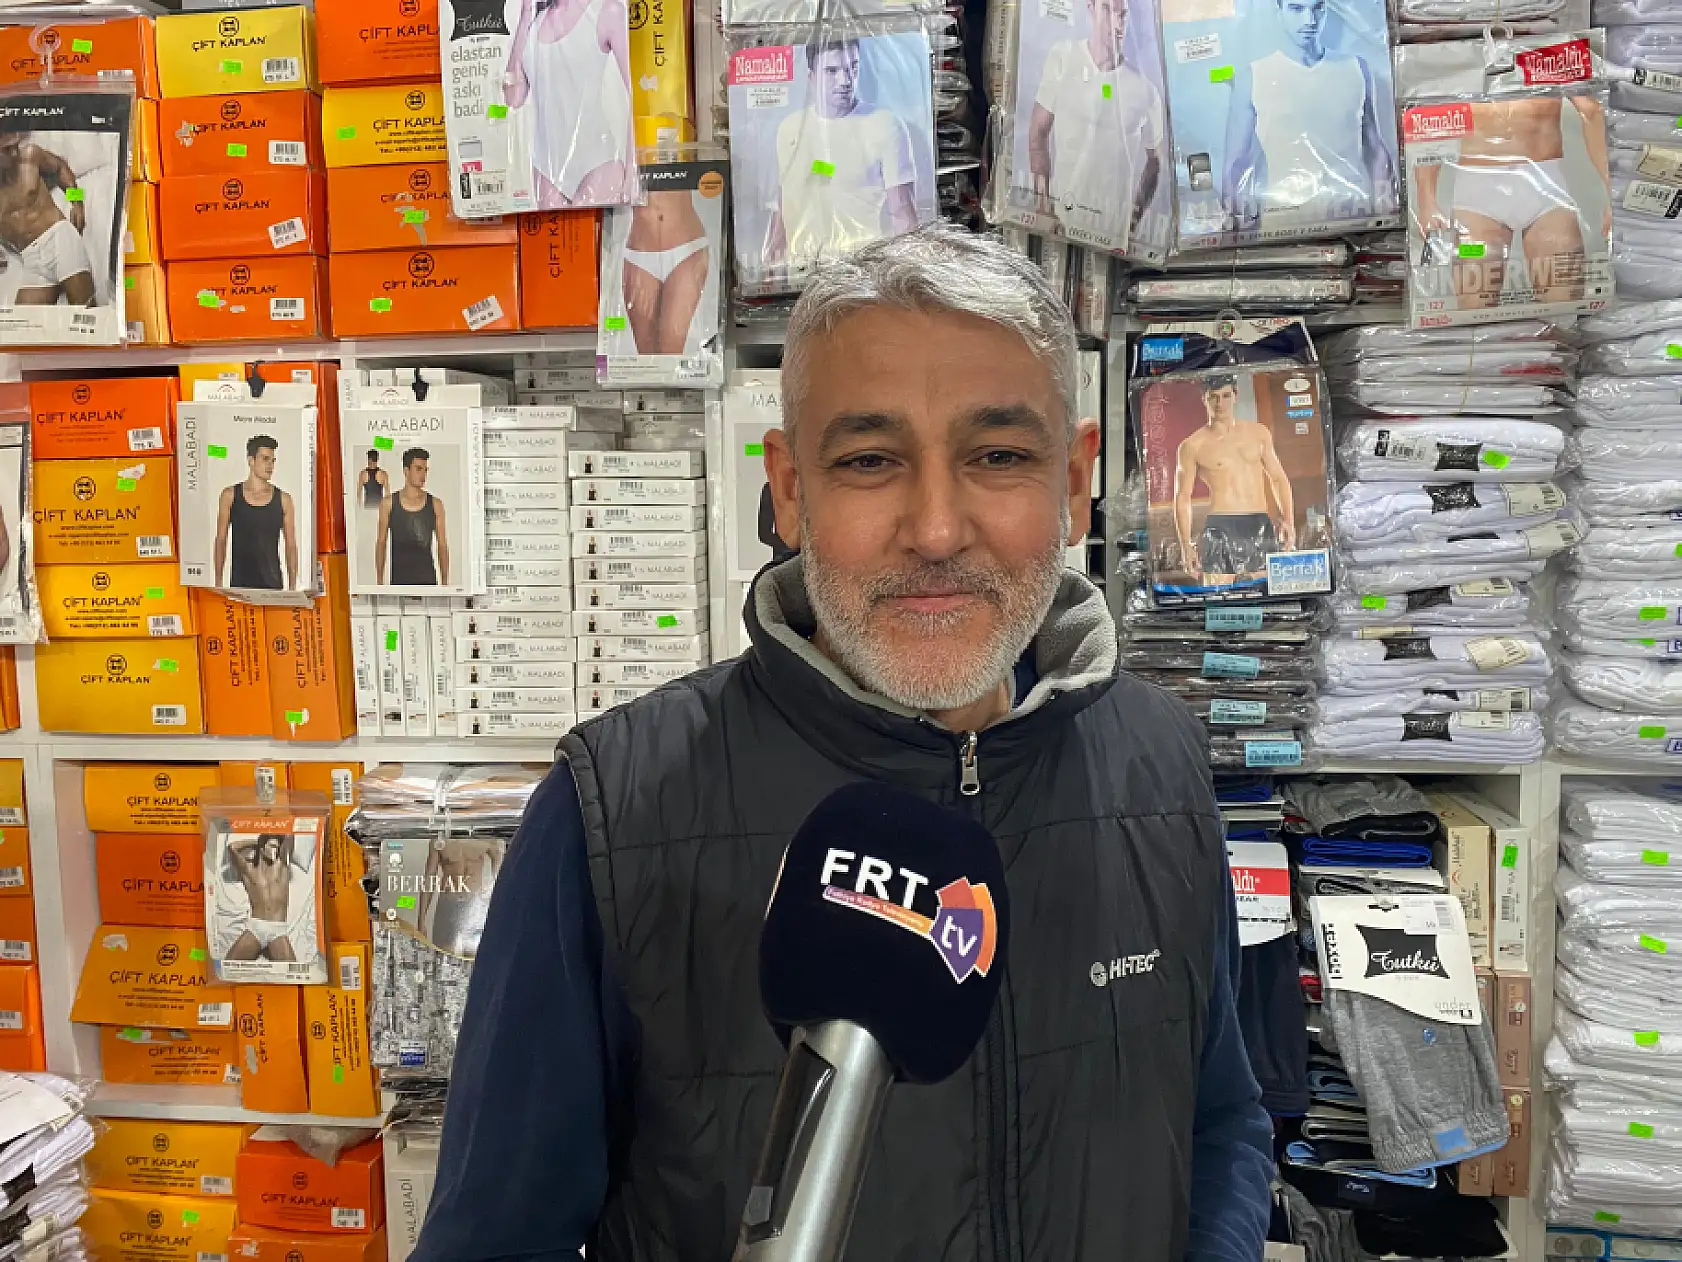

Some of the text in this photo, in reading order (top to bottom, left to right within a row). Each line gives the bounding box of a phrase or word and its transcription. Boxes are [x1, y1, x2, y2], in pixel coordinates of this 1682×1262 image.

[451, 45, 502, 62] elastan
[452, 61, 489, 83] geniş
[69, 409, 124, 423] KAPLAN
[367, 418, 445, 432] MALABADI
[74, 507, 138, 522] KAPLAN
[91, 596, 141, 607] KAPLAN
[387, 874, 472, 894] BERRAK
[820, 847, 930, 910] FRT
[942, 915, 978, 957] tv
[151, 1157, 197, 1169] KAPLAN
